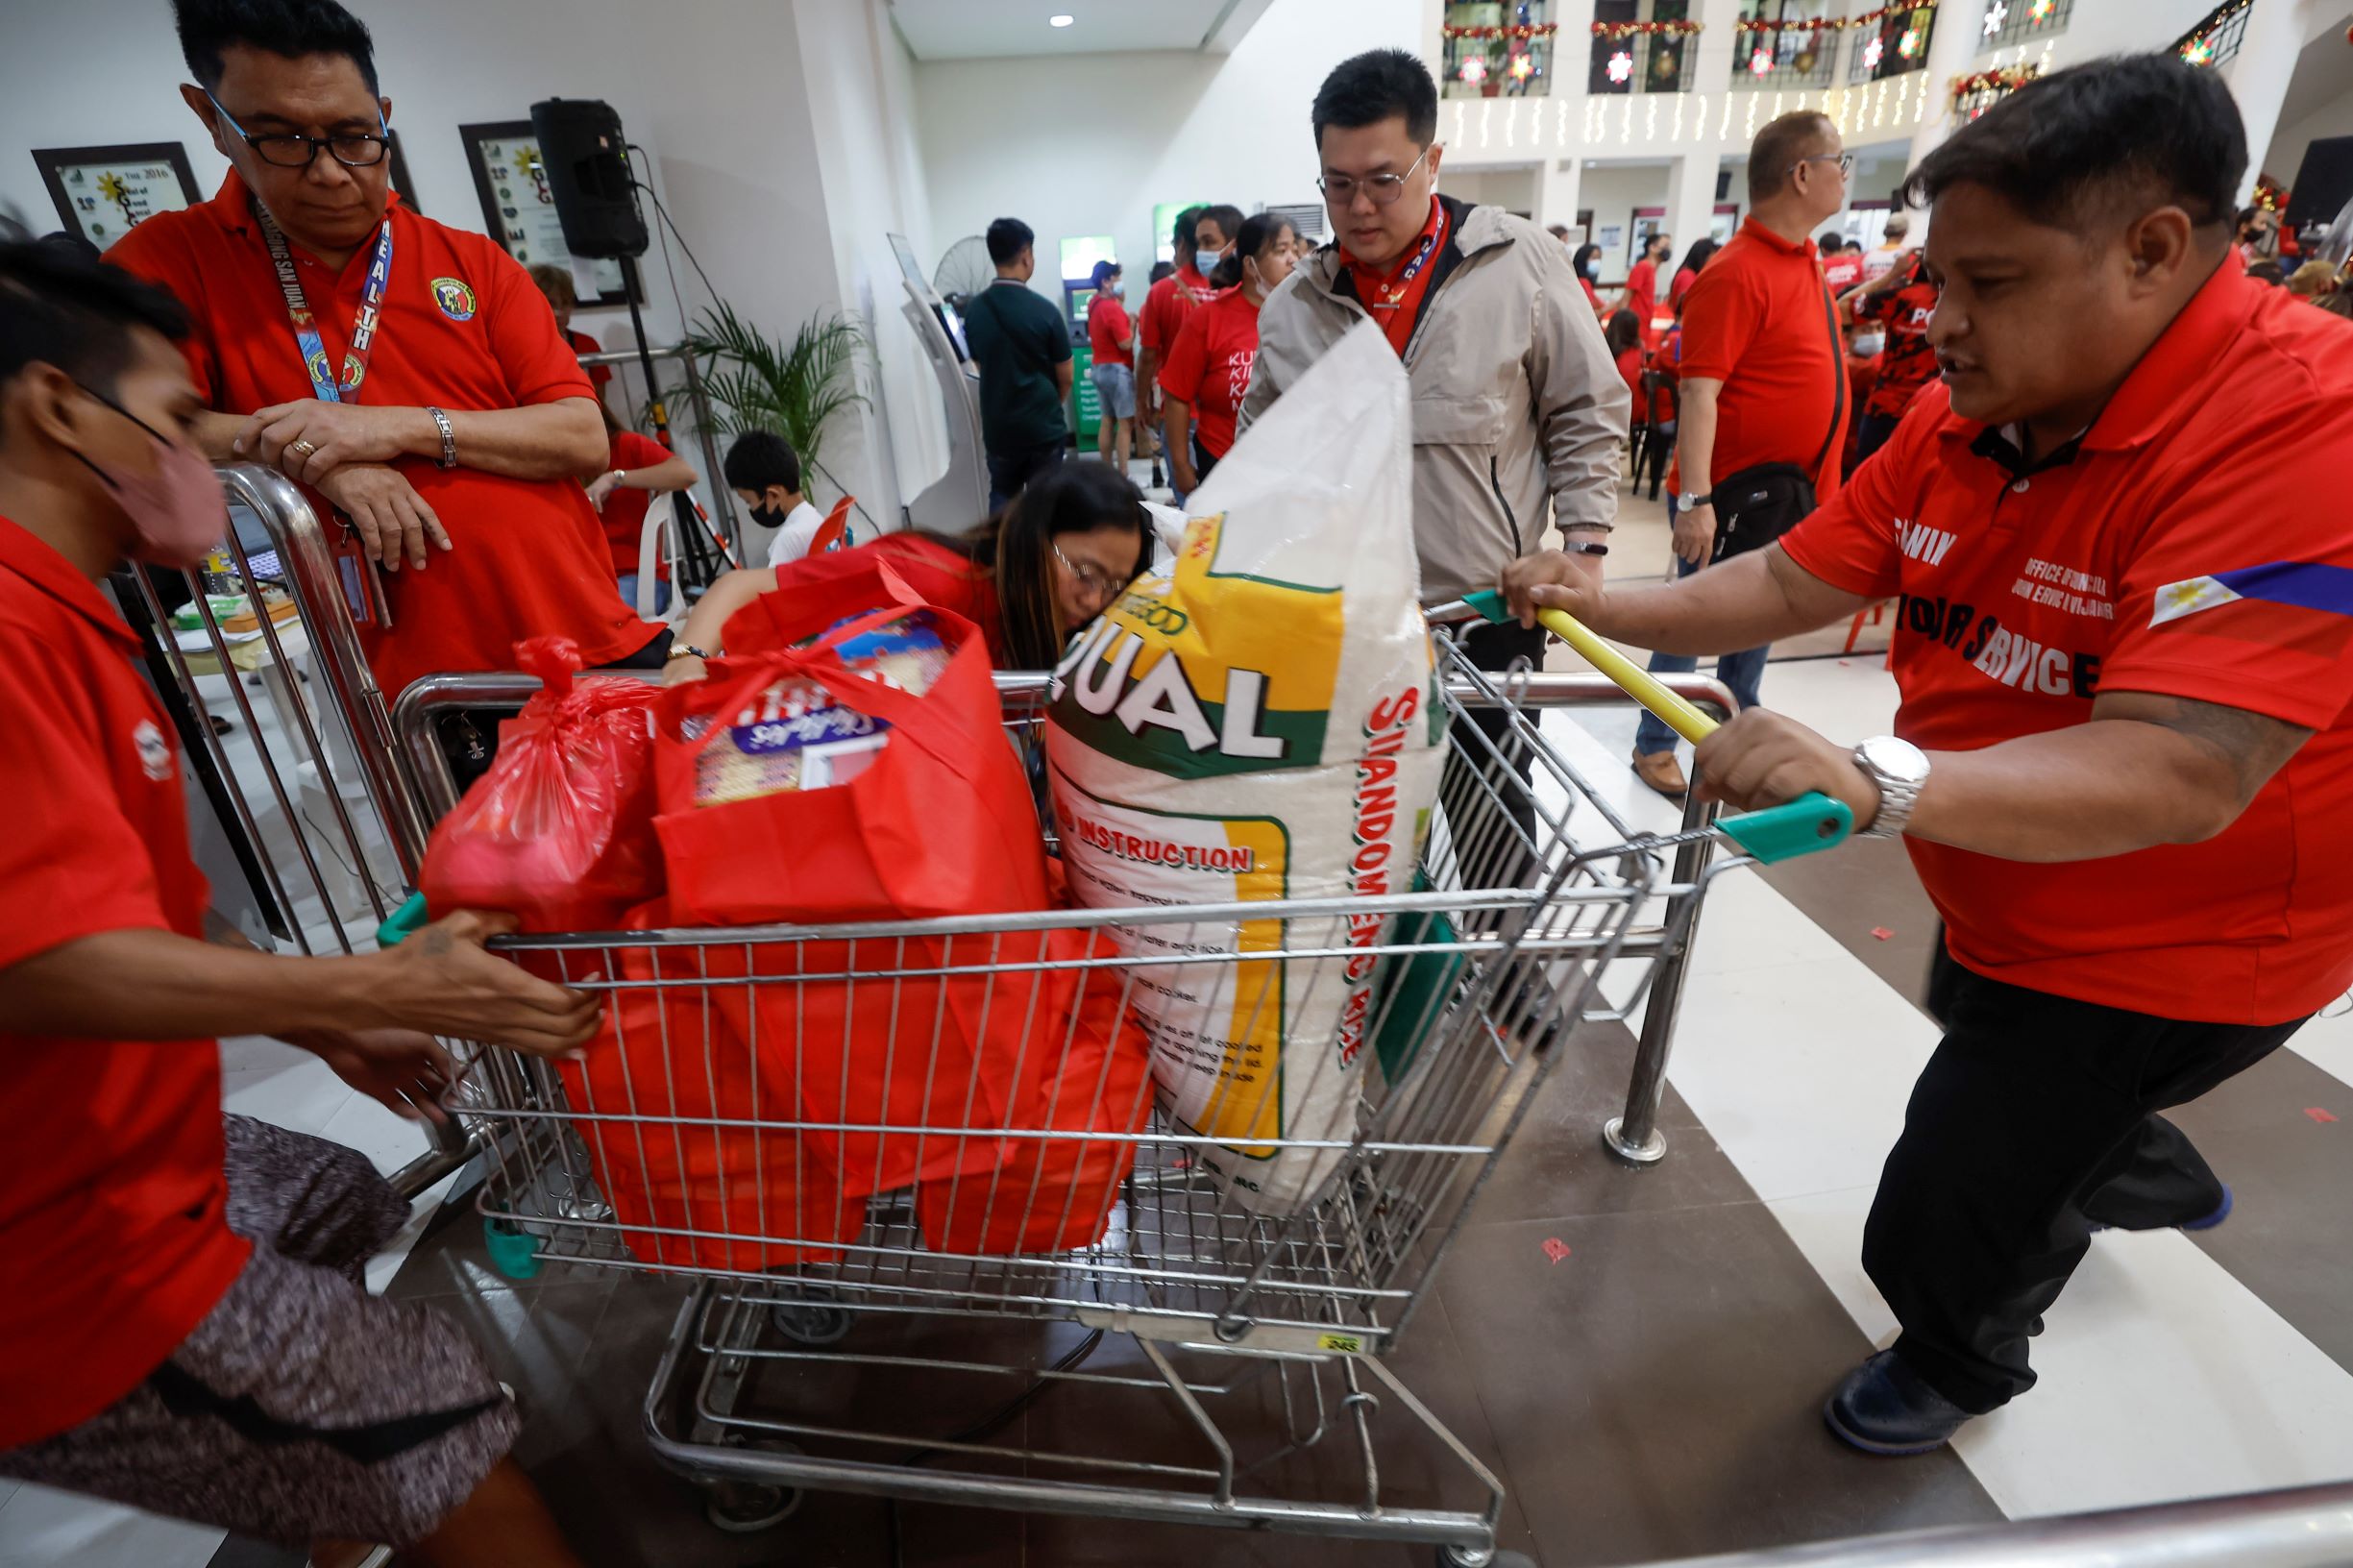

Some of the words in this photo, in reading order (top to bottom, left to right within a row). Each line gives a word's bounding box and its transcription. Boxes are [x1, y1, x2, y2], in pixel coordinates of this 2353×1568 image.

[143, 167, 169, 180] 2016
[275, 260, 297, 282] SAN
[282, 283, 307, 309] JUAN
[353, 219, 391, 351] HEALTH
[1229, 351, 1257, 367] KU
[2024, 557, 2064, 583] OFFICE
[1963, 615, 2100, 699] SERVICE
[1077, 817, 1252, 872] INSTRUCTION
